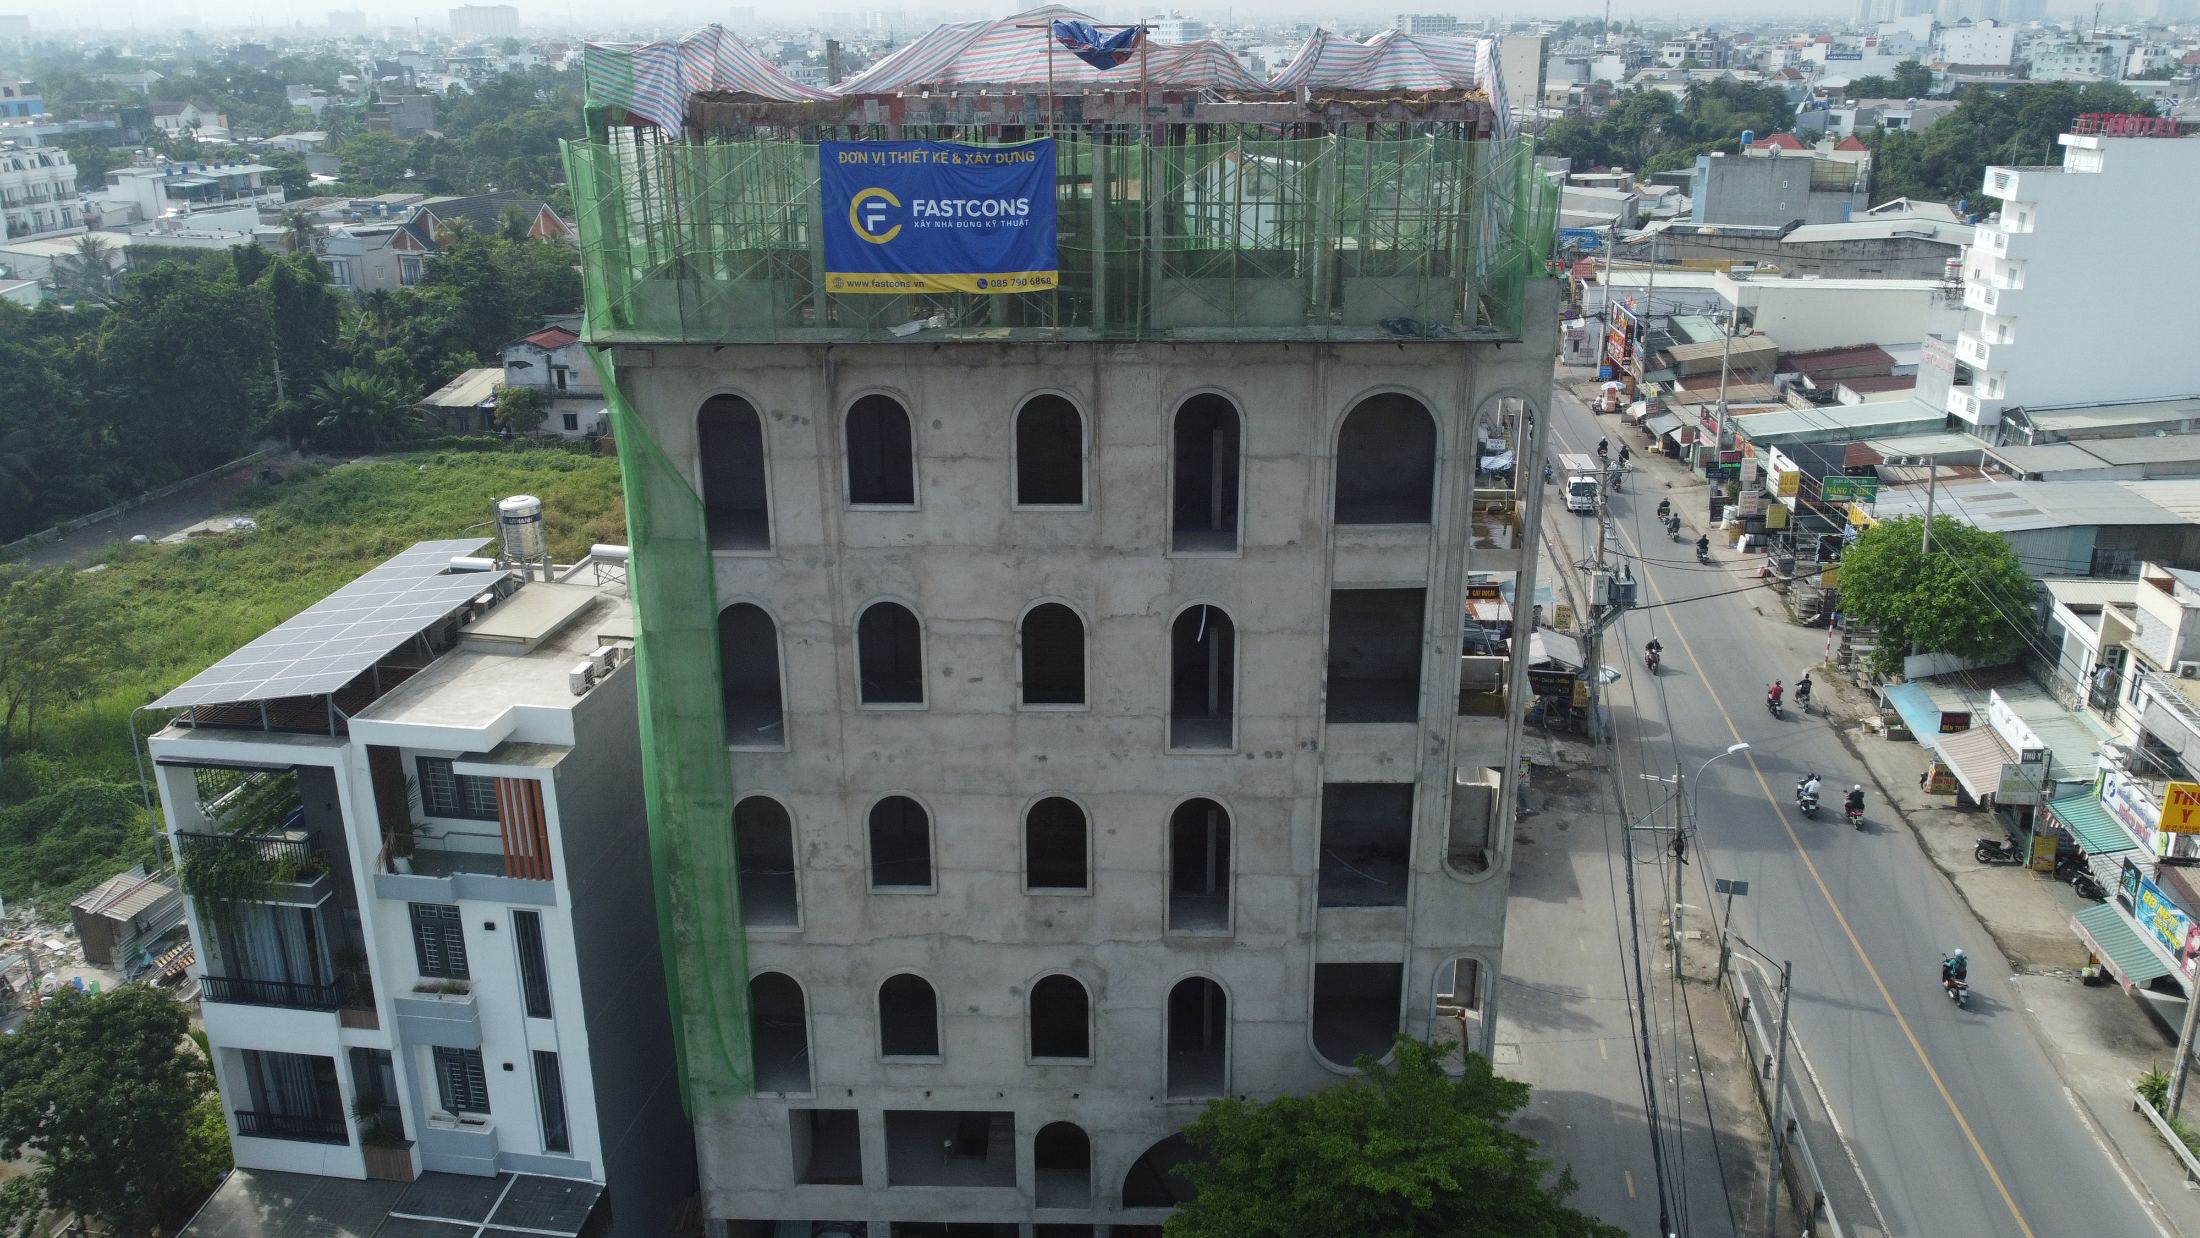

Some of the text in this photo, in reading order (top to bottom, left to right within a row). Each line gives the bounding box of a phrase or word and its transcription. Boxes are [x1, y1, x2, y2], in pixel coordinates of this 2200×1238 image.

[838, 151, 868, 164] ĐƠN
[872, 151, 886, 166] VỊ
[889, 147, 929, 164] THIẾT
[952, 154, 961, 165] &
[965, 152, 992, 166] XÂY
[996, 150, 1036, 166] DỰNG
[912, 198, 1030, 217] FASTCONS
[914, 219, 931, 228] XÂY
[934, 220, 953, 228] NHÀ
[956, 220, 982, 228] ĐÚNG
[1000, 218, 1030, 228] THUẬT
[847, 279, 925, 288] www.fastcons.vn
[990, 279, 1008, 288] 085
[1029, 277, 1051, 286] 6868
[2182, 809, 2193, 823] Y
